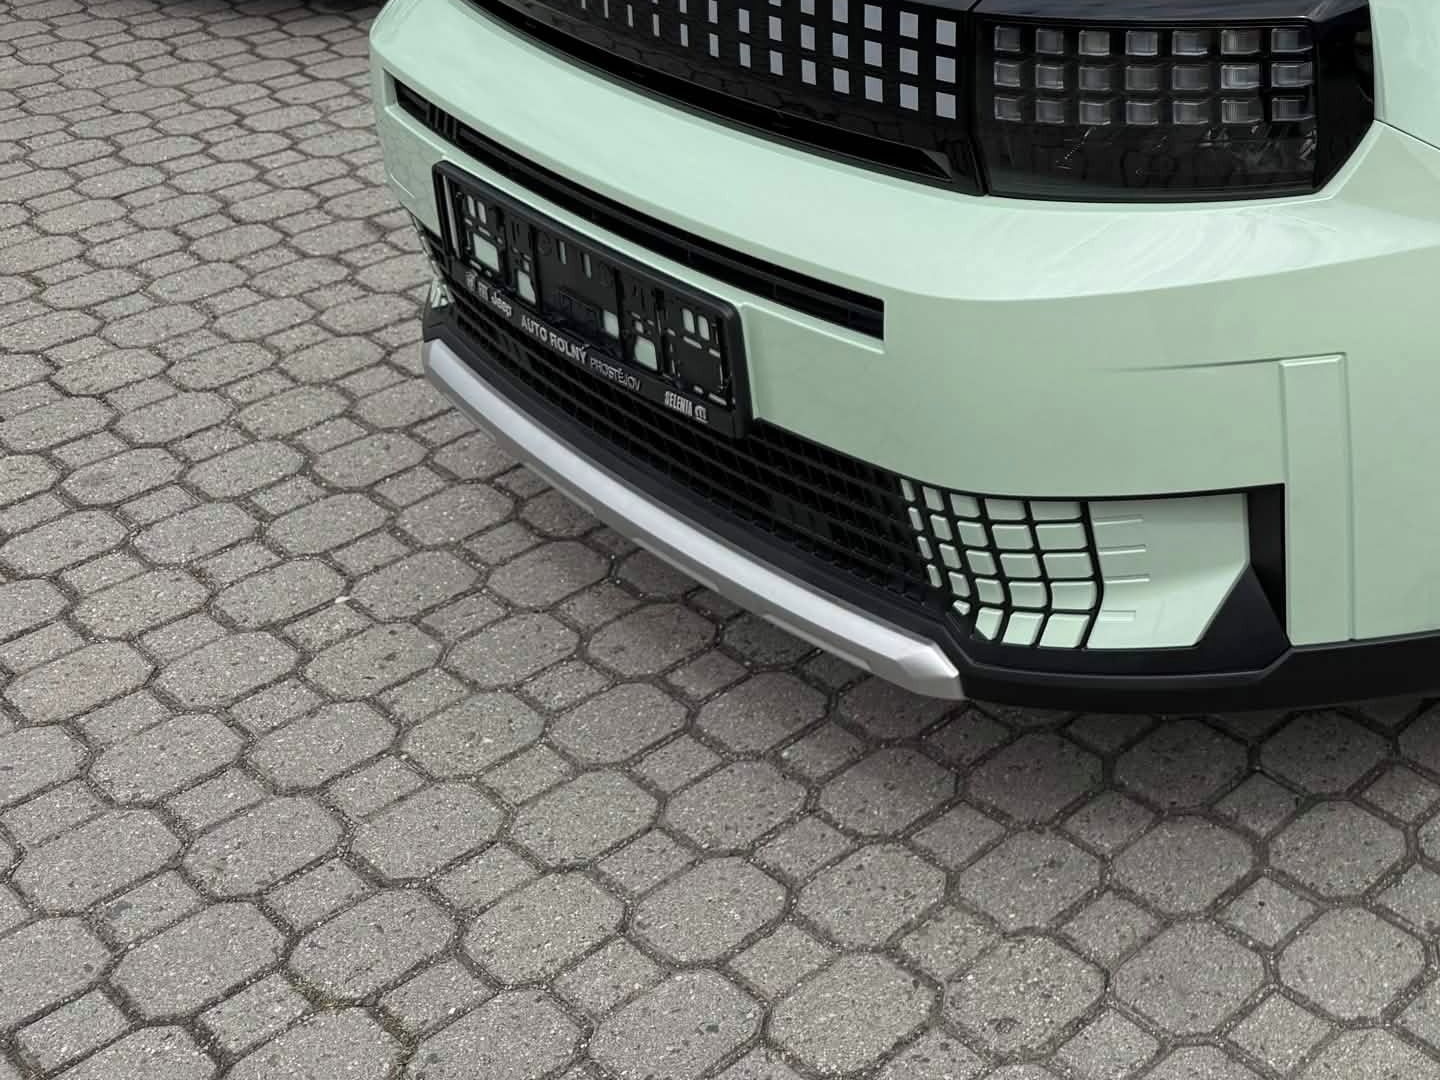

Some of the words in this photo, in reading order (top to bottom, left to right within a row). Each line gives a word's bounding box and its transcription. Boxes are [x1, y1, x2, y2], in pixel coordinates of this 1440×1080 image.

[491, 289, 512, 317] Jeep
[521, 315, 549, 340] AUTO
[549, 331, 588, 365] ROLNÝ
[664, 391, 693, 417] SELENIA
